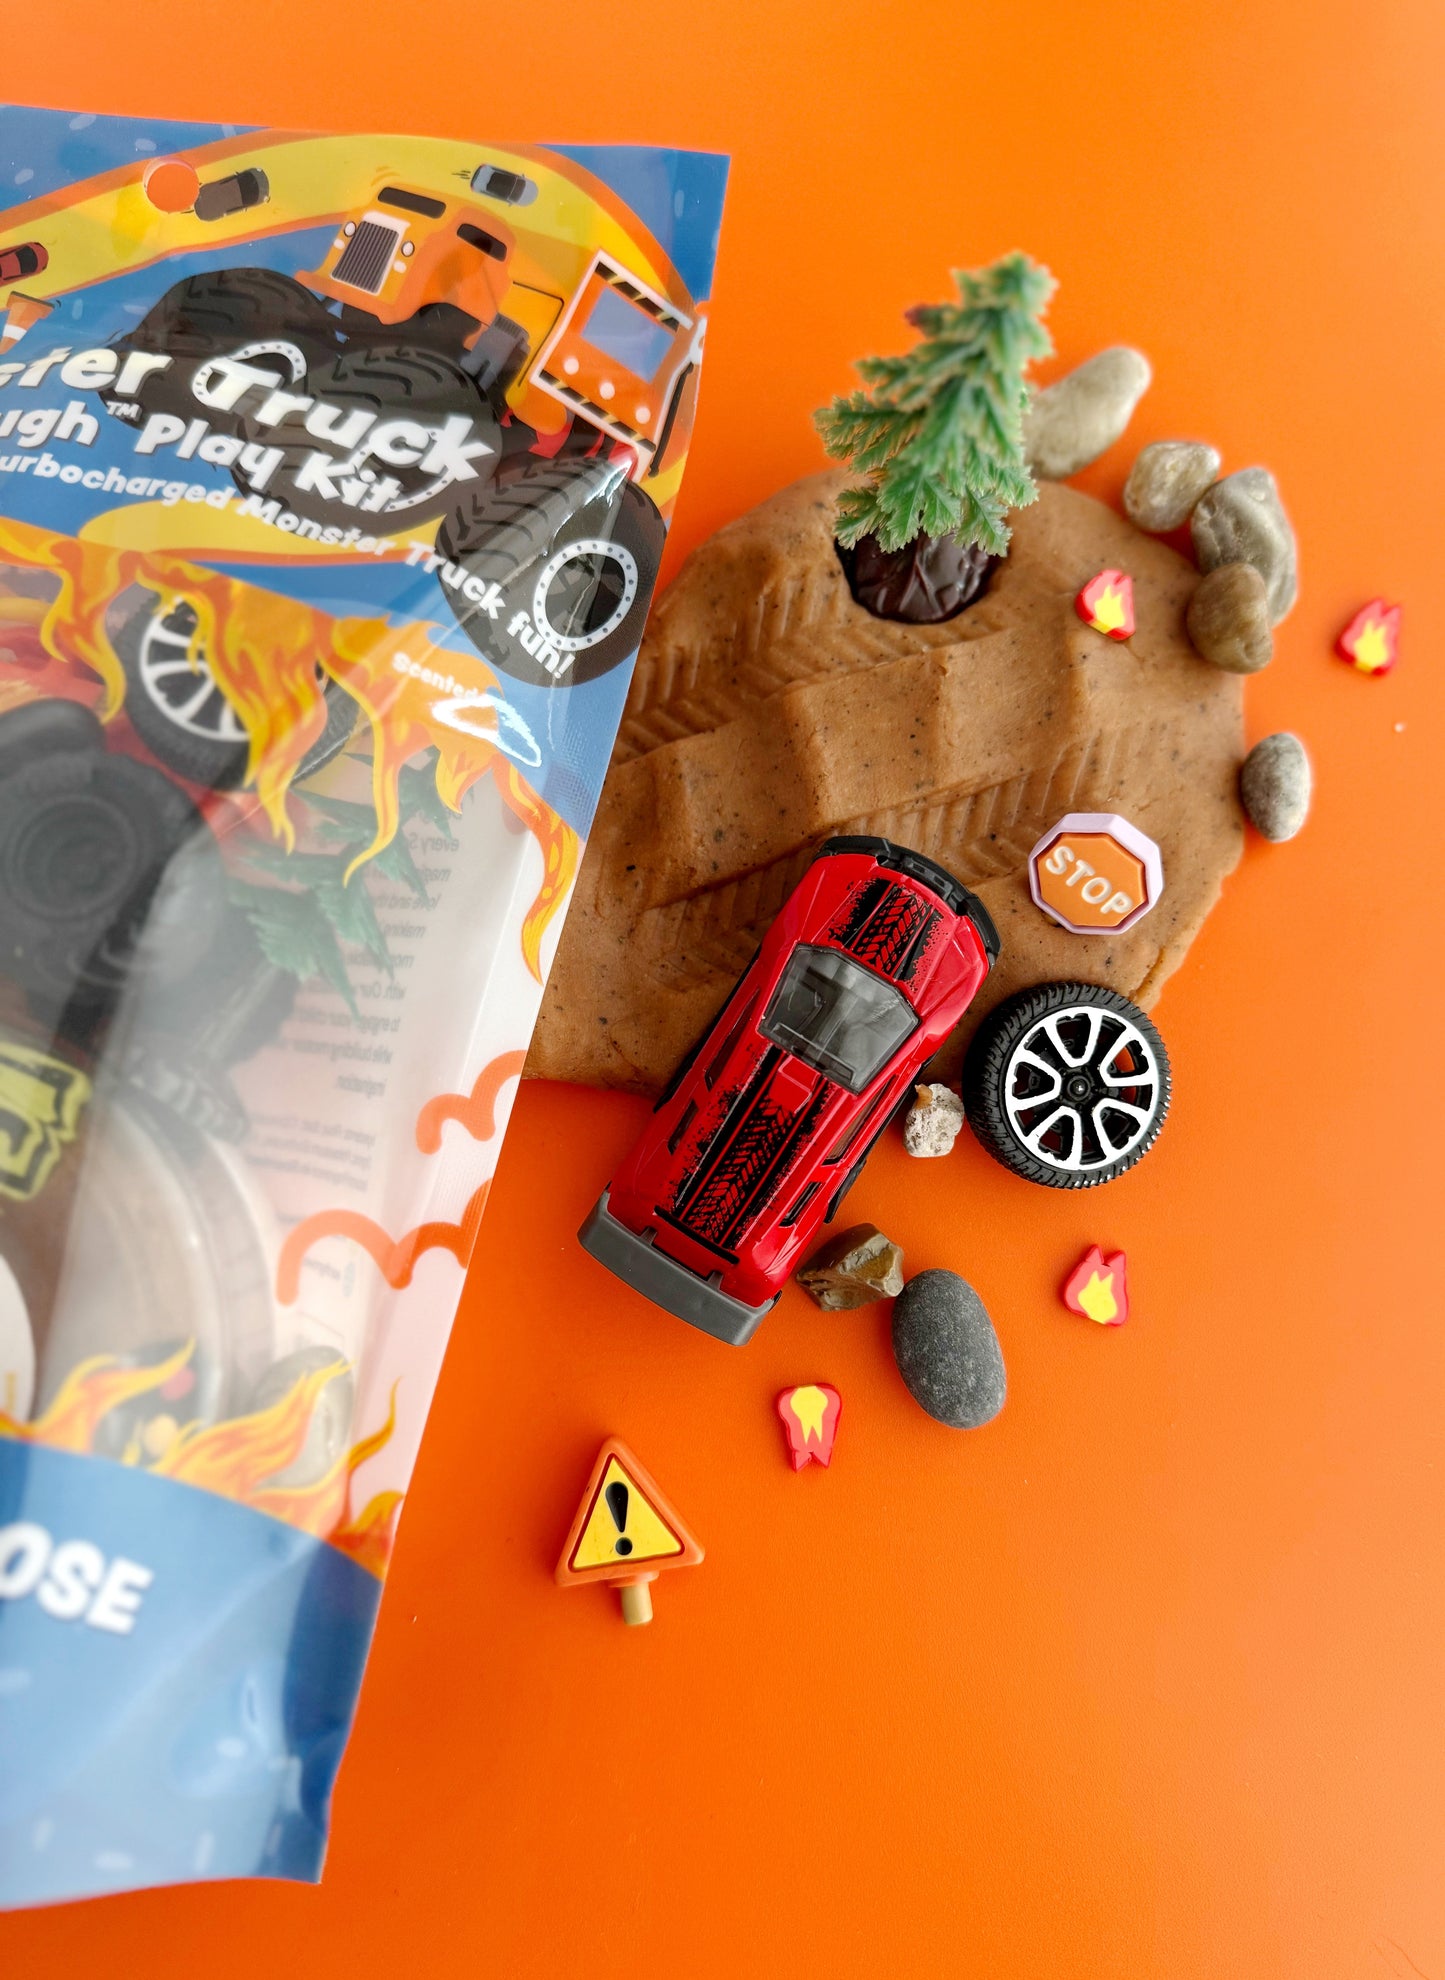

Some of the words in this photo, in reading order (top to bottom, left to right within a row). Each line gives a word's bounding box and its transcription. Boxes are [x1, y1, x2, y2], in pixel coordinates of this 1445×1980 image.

[134, 413, 285, 492] Play
[294, 450, 402, 514] Kit
[194, 352, 495, 482] Truck
[236, 494, 397, 556] Monster
[405, 540, 506, 619] Truck
[507, 611, 575, 679] fun!
[1045, 846, 1133, 914] STOP
[0, 1521, 155, 1634] OSE
